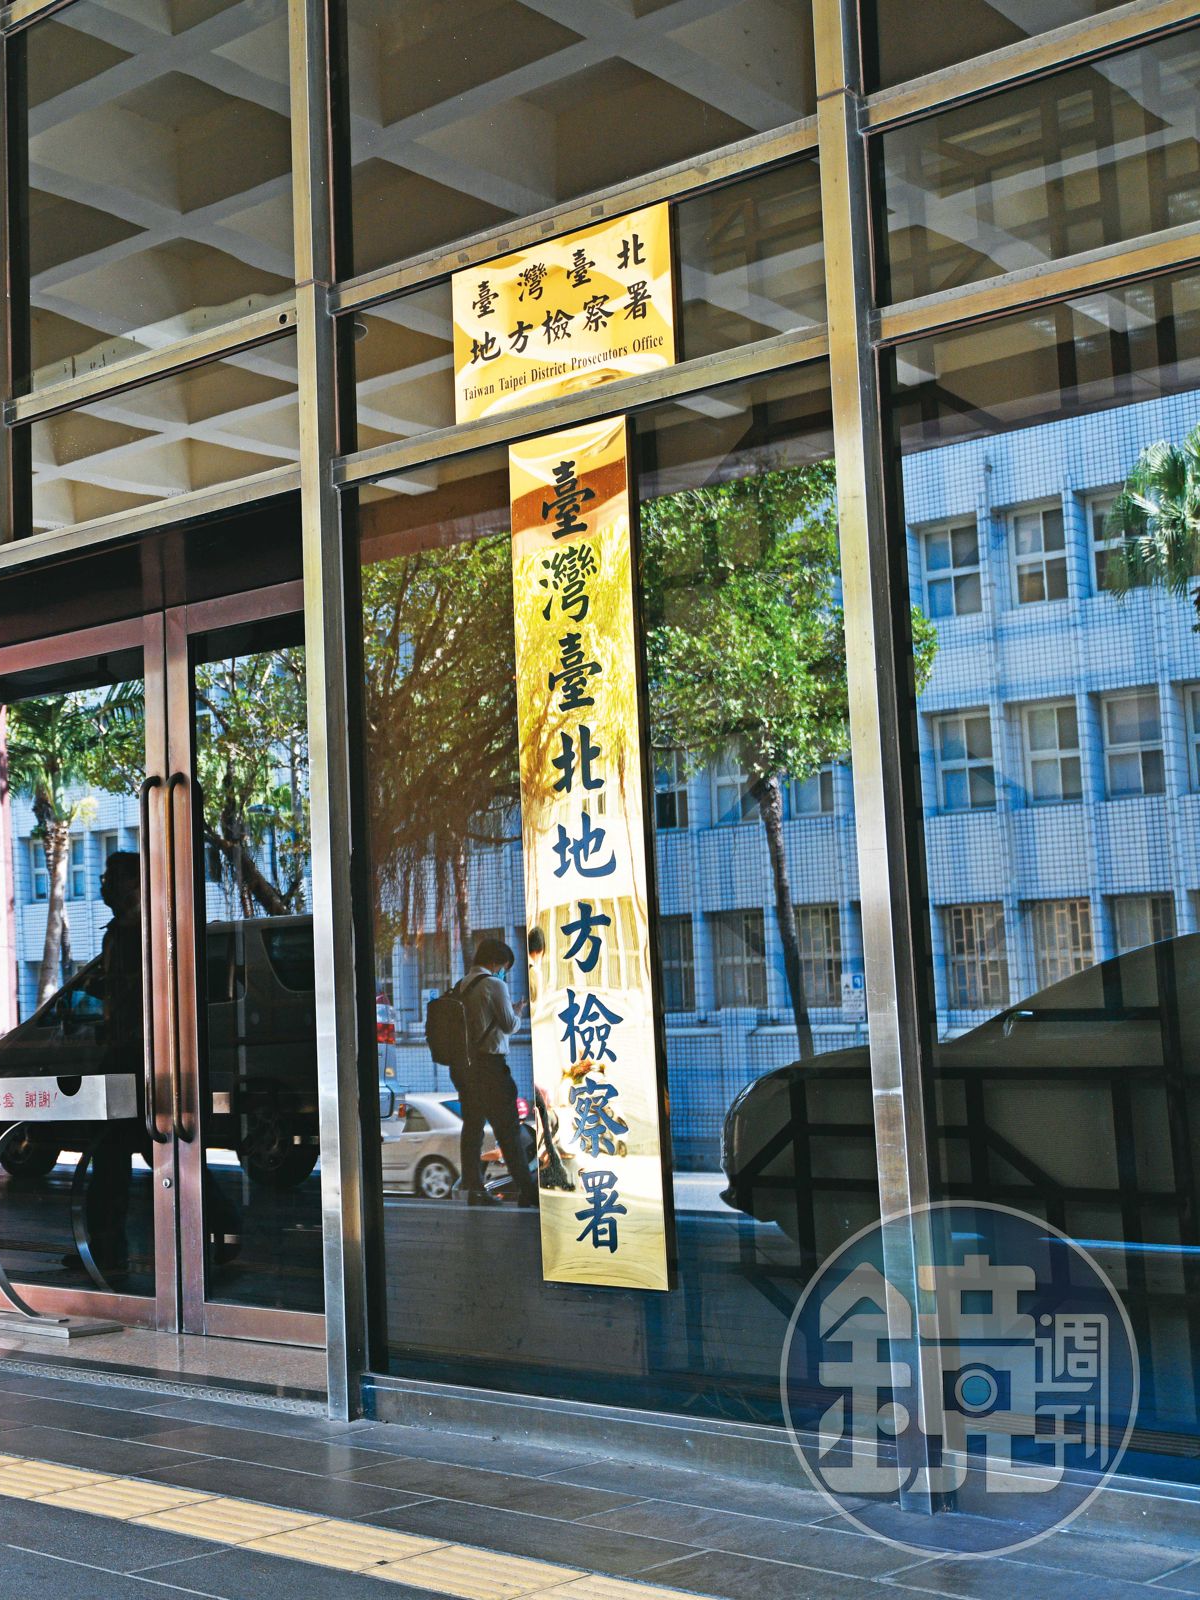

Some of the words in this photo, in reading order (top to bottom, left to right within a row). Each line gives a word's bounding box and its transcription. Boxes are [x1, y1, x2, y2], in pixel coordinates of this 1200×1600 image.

[472, 233, 647, 319] 臺灣臺北
[470, 280, 651, 365] 地方檢察署
[463, 386, 495, 401] Taiwan
[498, 374, 527, 391] Taipei
[531, 361, 567, 382] District
[571, 345, 629, 370] Prosecutors
[632, 335, 664, 353] Office
[540, 460, 629, 1254] 臺灣臺北地方檢察署
